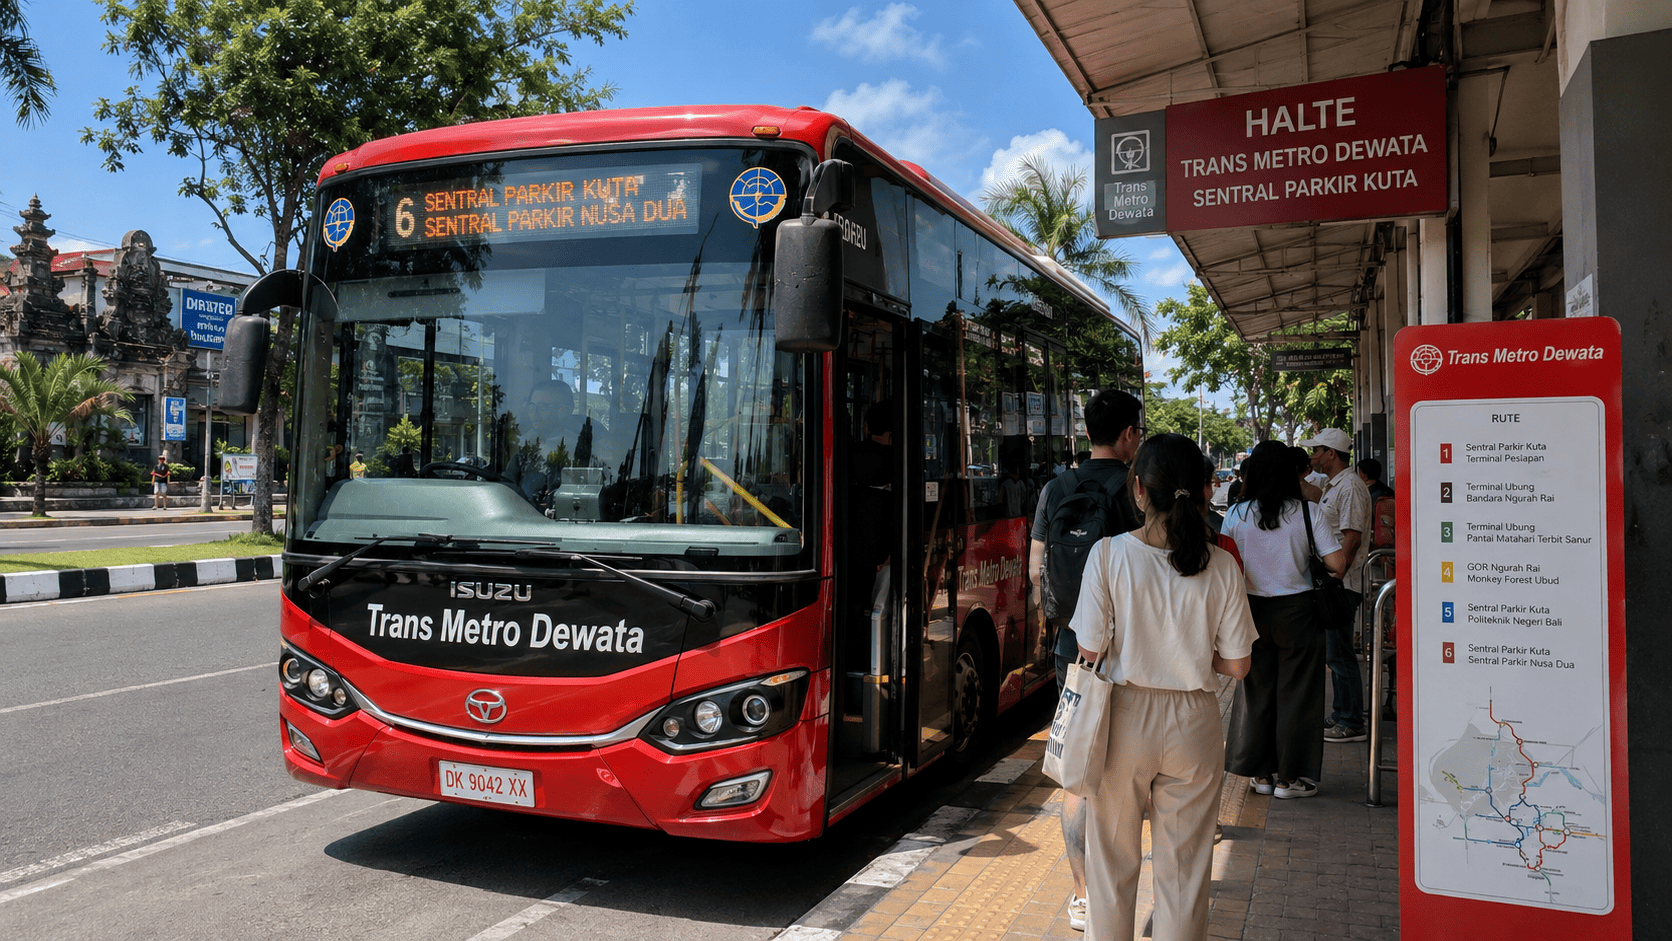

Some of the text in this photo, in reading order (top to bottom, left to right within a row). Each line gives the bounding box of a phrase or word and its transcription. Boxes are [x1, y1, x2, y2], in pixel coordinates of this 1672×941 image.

[1247, 97, 1355, 137] HALTE
[1181, 134, 1428, 177] TRANS METRO DEWATA
[1113, 181, 1147, 193] Trans
[1194, 169, 1418, 207] SENTRAL PARKIR KUTA
[425, 175, 639, 212] SENTRAL PARKIR KUTA
[1113, 194, 1149, 207] Metro
[396, 198, 414, 237] 6
[425, 197, 687, 238] SENTRAL PARKIR NUSA DUA
[1108, 207, 1154, 221] Dewata
[1447, 344, 1604, 365] Trans Metro Dewata
[1491, 413, 1521, 423] RUTE
[1465, 442, 1547, 452] Sentral Parkir Kuta
[1442, 448, 1449, 459] 1
[1465, 454, 1503, 463] Terminal
[1443, 486, 1451, 498] 2
[1465, 482, 1535, 493] Terminal Ubung
[1466, 493, 1555, 505] Bandara Ngurah Rai
[1443, 526, 1451, 538] 3
[1466, 522, 1536, 534] Terminal Ubung
[1466, 533, 1593, 544] Pantai Matahari Terbit Sanur
[1443, 567, 1451, 578] 4
[1466, 562, 1541, 574] GOR Ngurah Rai
[958, 566, 978, 591] Trans
[1467, 574, 1560, 586] Monkey Forest Ubud
[1444, 606, 1452, 618] 5
[1467, 602, 1550, 615] Sentral Parkir Kuta
[1467, 614, 1563, 628] Politeknik Negeri Bali
[368, 604, 643, 653] Trans Metro Dewata
[1444, 647, 1453, 658] 6
[1468, 643, 1551, 656] Sentral Parkir Kuta
[1468, 655, 1575, 669] Sentral Parkir Nusa Dua
[446, 770, 527, 797] DK 9042 XX
